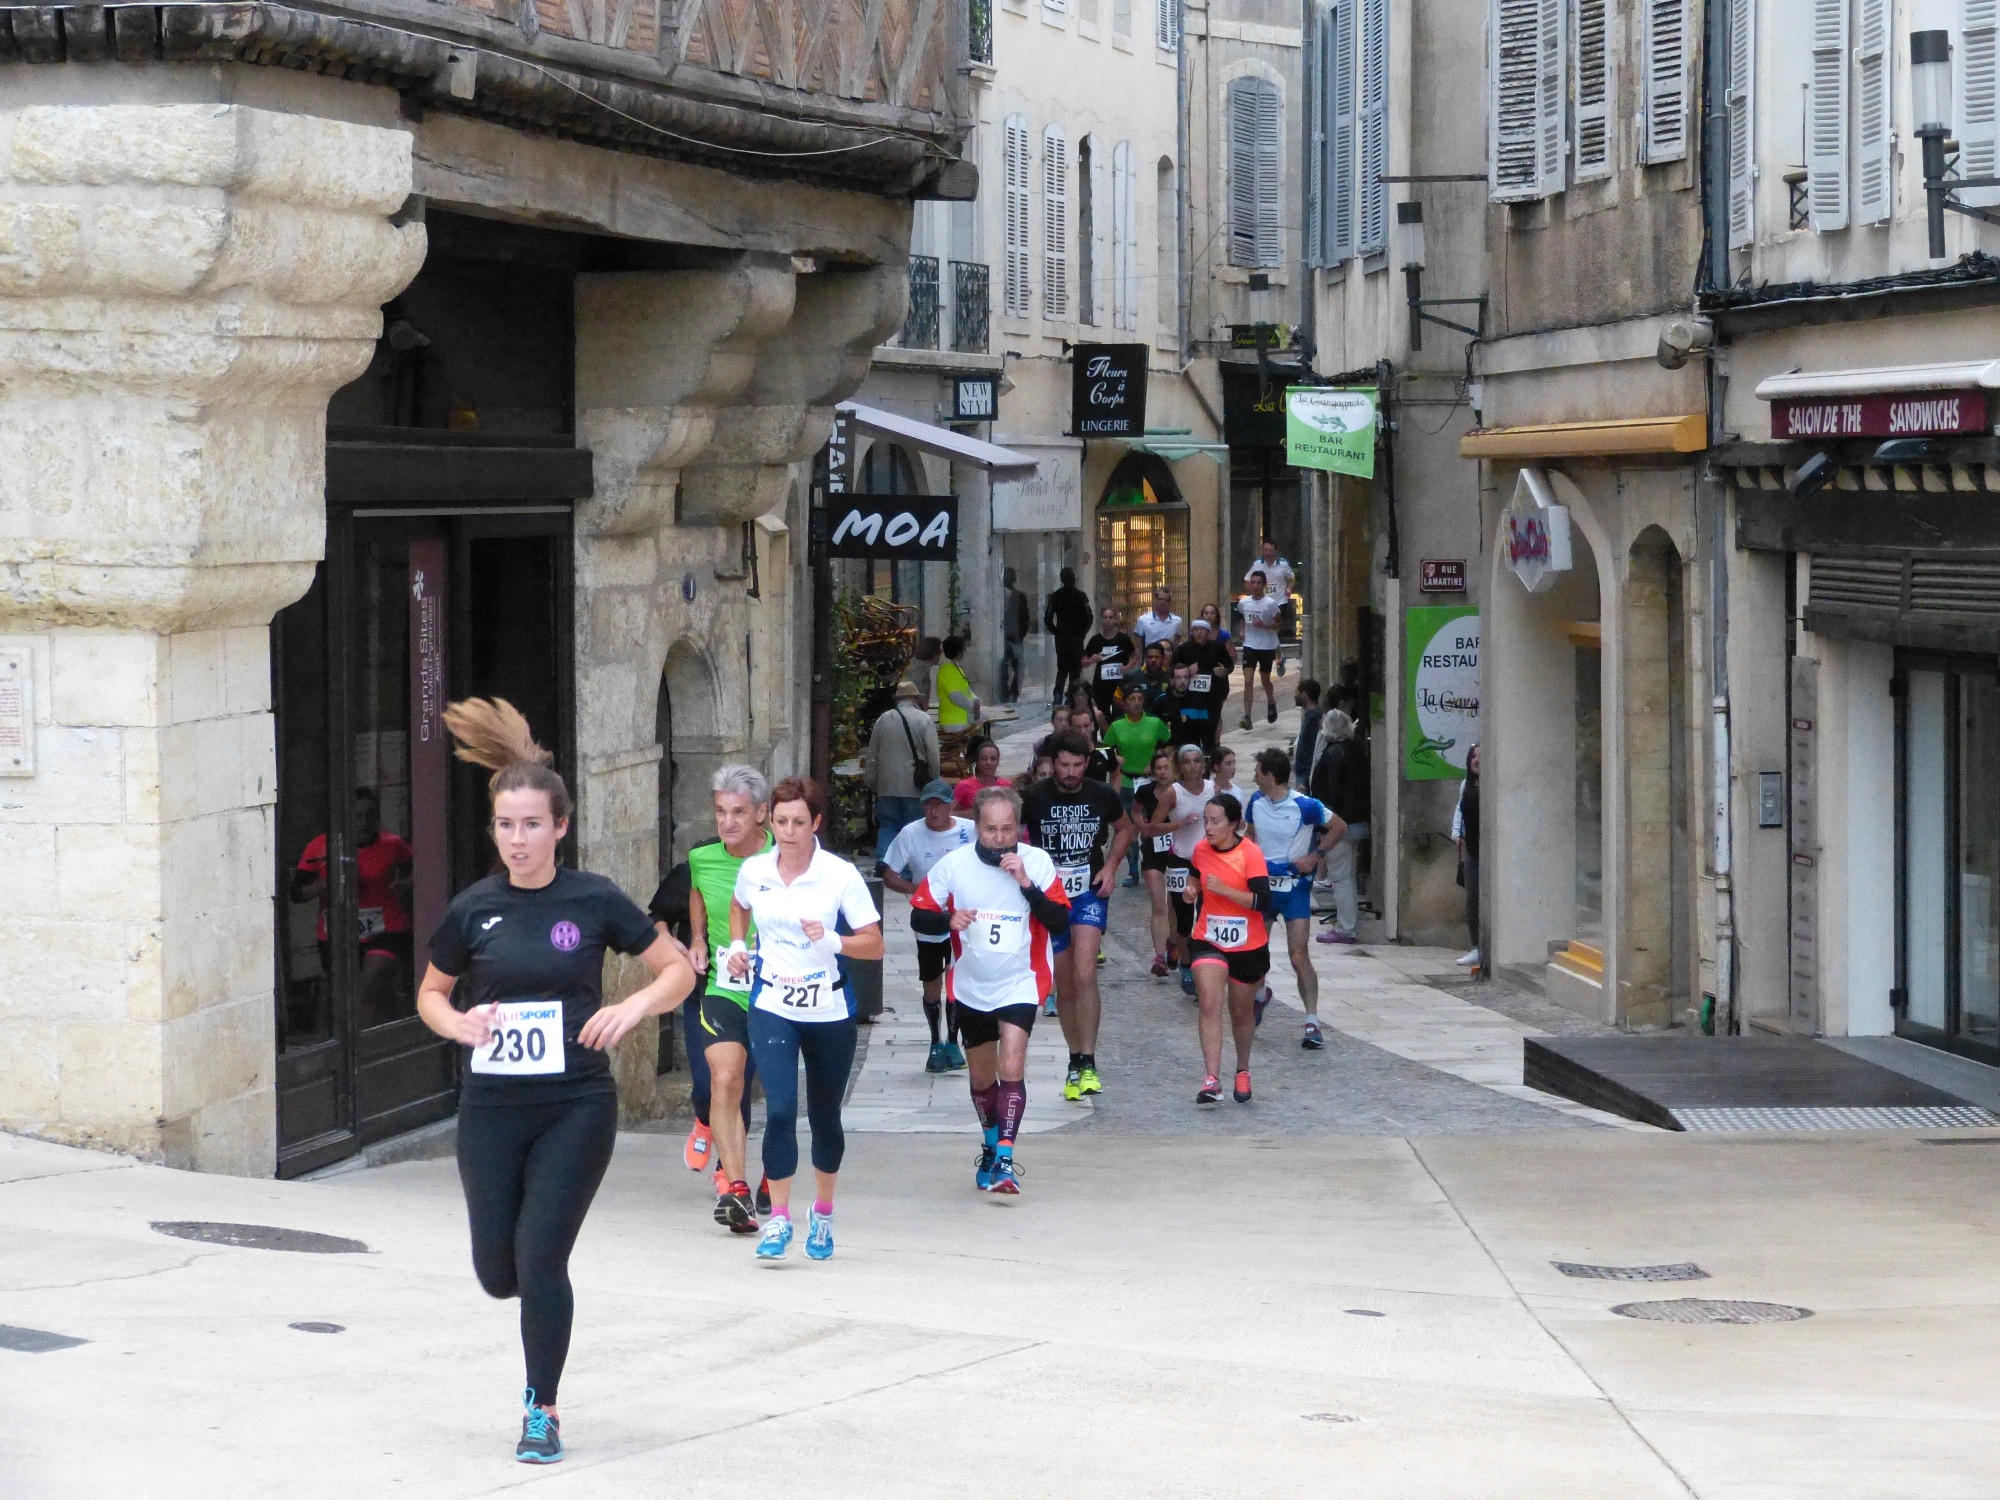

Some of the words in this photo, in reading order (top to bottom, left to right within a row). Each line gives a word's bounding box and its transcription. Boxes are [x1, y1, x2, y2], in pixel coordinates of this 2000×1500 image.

[1086, 356, 1128, 378] Fleurs
[963, 383, 988, 397] NEW
[1089, 382, 1125, 409] Corps
[1788, 406, 1822, 435] SALON
[1823, 405, 1838, 433] DE
[1842, 404, 1863, 433] THE
[1889, 398, 1960, 433] SANDWICHS
[1081, 419, 1130, 432] LINGERIE
[1319, 434, 1343, 445] BAR
[1294, 443, 1367, 461] RESTAURANT
[832, 509, 949, 549] MOA
[1441, 565, 1457, 574] RUE
[1423, 577, 1463, 586] LAMARTINE
[419, 596, 428, 654] Sites
[1192, 680, 1207, 690] 129
[420, 657, 429, 741] Grands
[1050, 804, 1090, 818] GERSOIS
[1040, 825, 1058, 835] NOUS
[1060, 822, 1100, 834] DOMINERONS
[1042, 834, 1056, 850] LE
[1061, 877, 1083, 893] 45
[1166, 875, 1185, 888] 260
[978, 912, 1023, 923] INTERSPORT
[989, 924, 1001, 945] 5
[1213, 926, 1240, 943] 140
[778, 970, 827, 985] INTERSPORT
[782, 983, 821, 1008] 227
[498, 1009, 557, 1021] TERSPORT
[487, 1026, 546, 1062] 230
